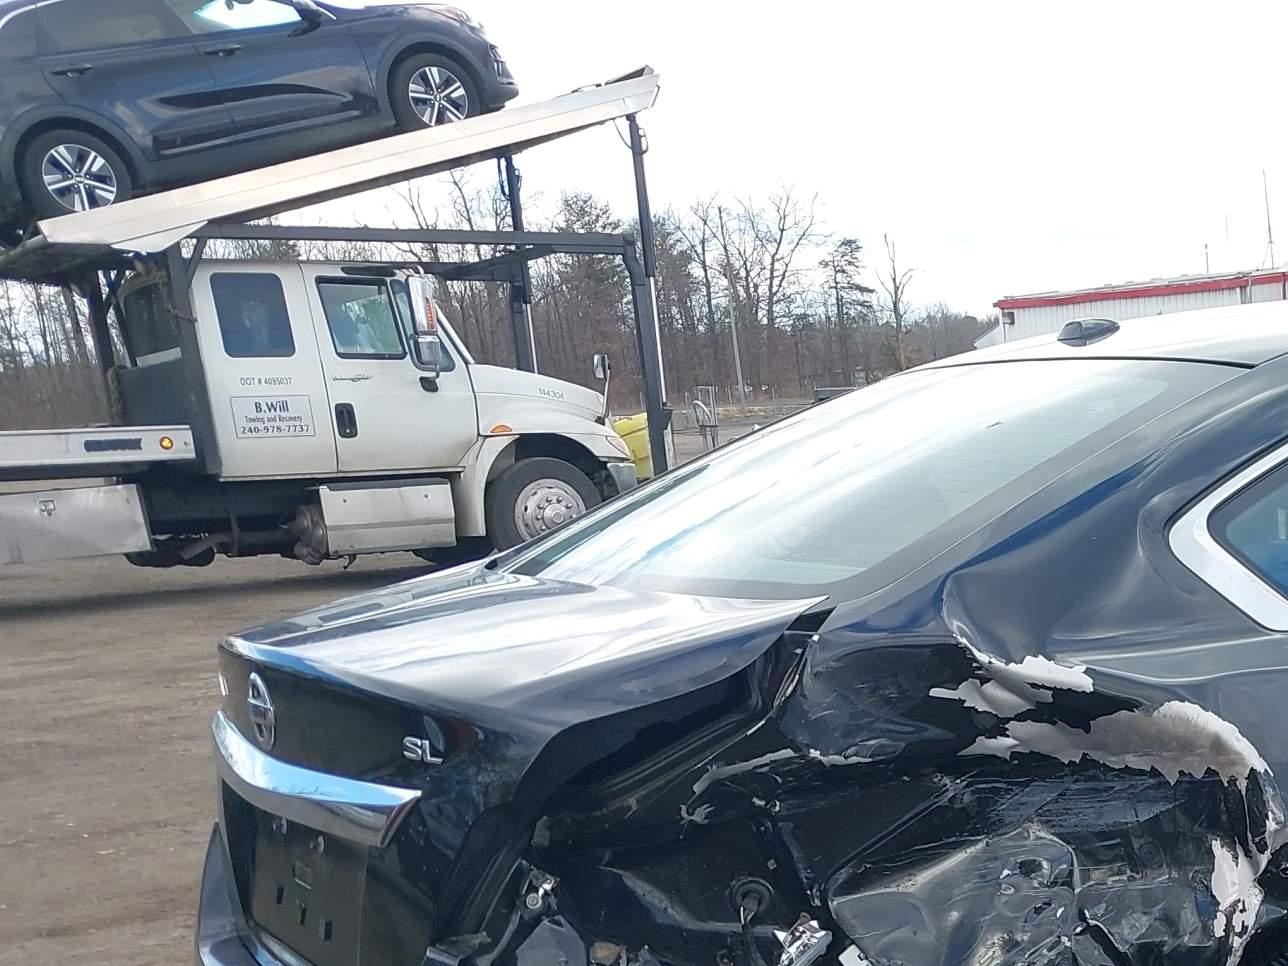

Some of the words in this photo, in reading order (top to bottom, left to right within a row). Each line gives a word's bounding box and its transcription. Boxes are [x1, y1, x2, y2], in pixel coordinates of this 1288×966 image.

[240, 377, 255, 386] DOT
[254, 400, 289, 413] B.Will
[245, 415, 265, 424] Towing
[267, 415, 278, 423] and
[278, 415, 303, 424] Recovery
[240, 425, 309, 434] 240-978-7737
[403, 736, 443, 764] SL
